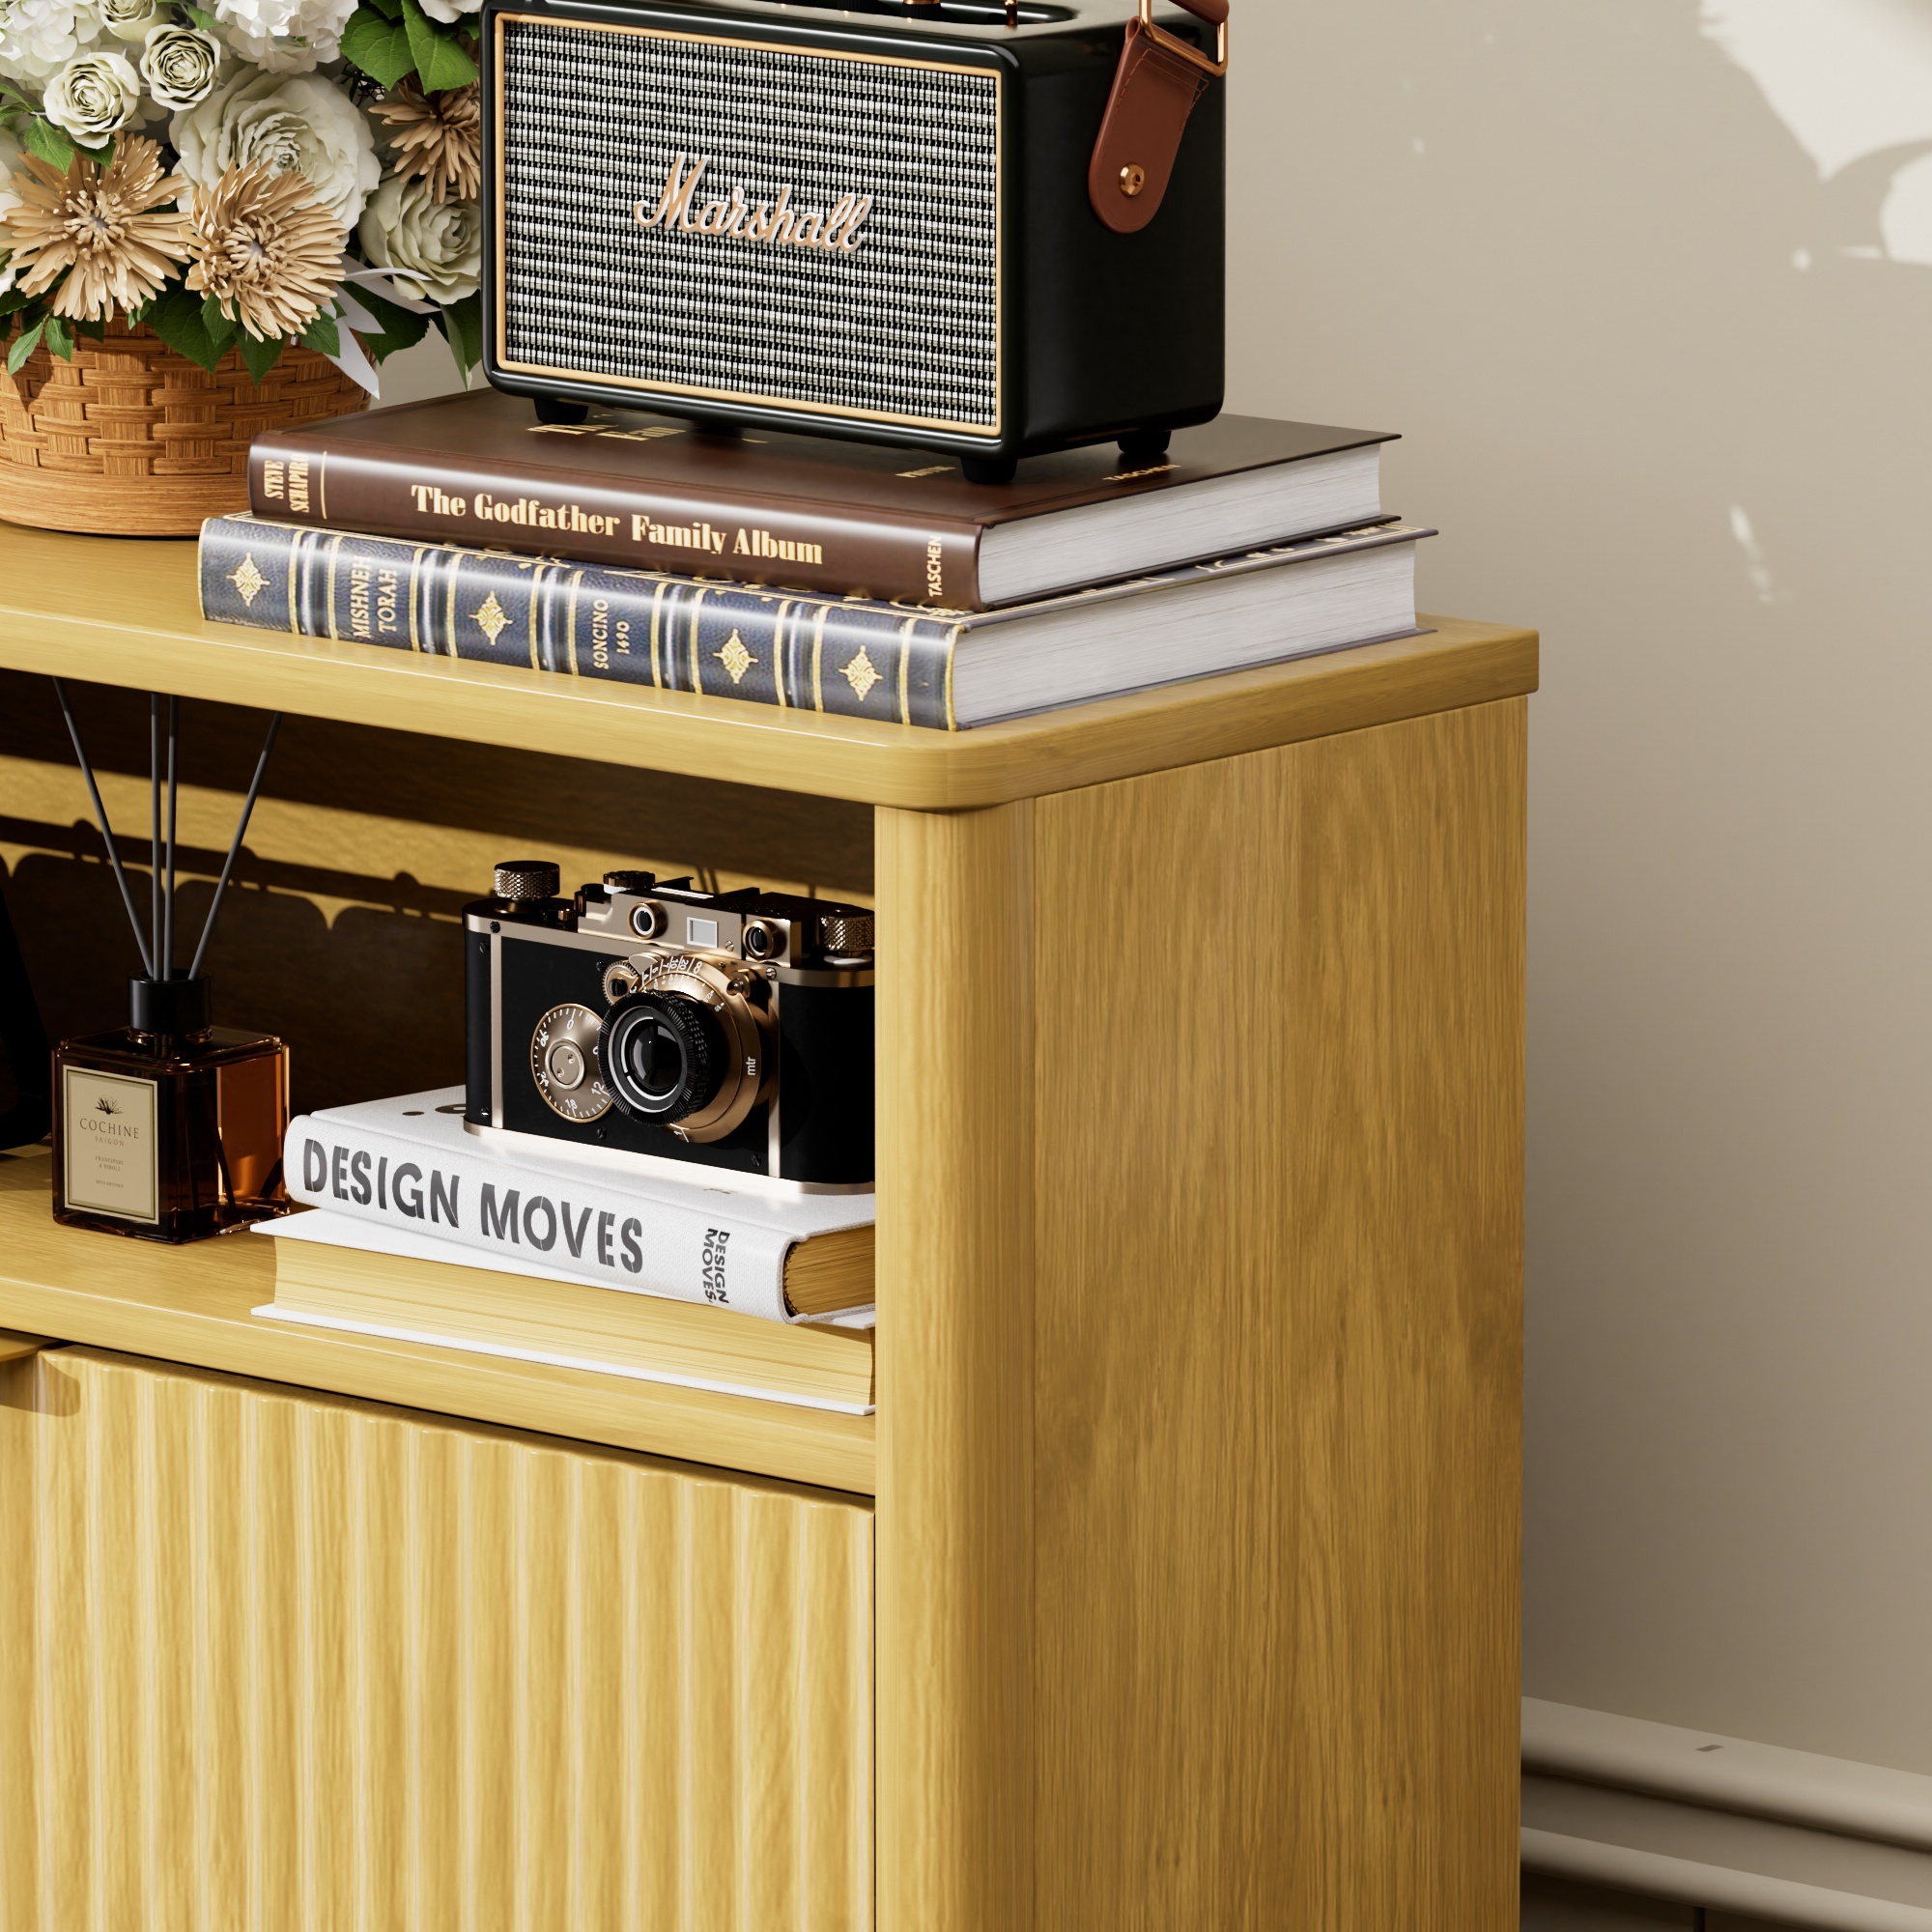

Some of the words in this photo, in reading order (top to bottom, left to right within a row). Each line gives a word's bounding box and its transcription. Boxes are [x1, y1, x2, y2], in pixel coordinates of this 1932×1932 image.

[633, 152, 873, 253] Marshall
[264, 460, 284, 499] STEVE
[288, 453, 309, 513] SCHAPIRO
[411, 484, 467, 517] The
[473, 493, 621, 536] Godfather
[631, 514, 726, 554] Family
[732, 527, 823, 565] Album
[926, 535, 943, 597] TASCHEN
[350, 555, 372, 639] MISHNEH
[377, 568, 398, 633] TORAH
[592, 599, 610, 669] SONCINO
[615, 620, 631, 654] 1490
[591, 1081, 606, 1095] 12
[746, 1056, 756, 1076] mtr
[79, 1118, 139, 1140] COCHINE
[564, 1098, 578, 1110] 18
[95, 1135, 125, 1147] SAIGON
[303, 1138, 460, 1229] DESIGN
[480, 1182, 643, 1273] MOVES
[715, 1231, 731, 1304] DESIGN
